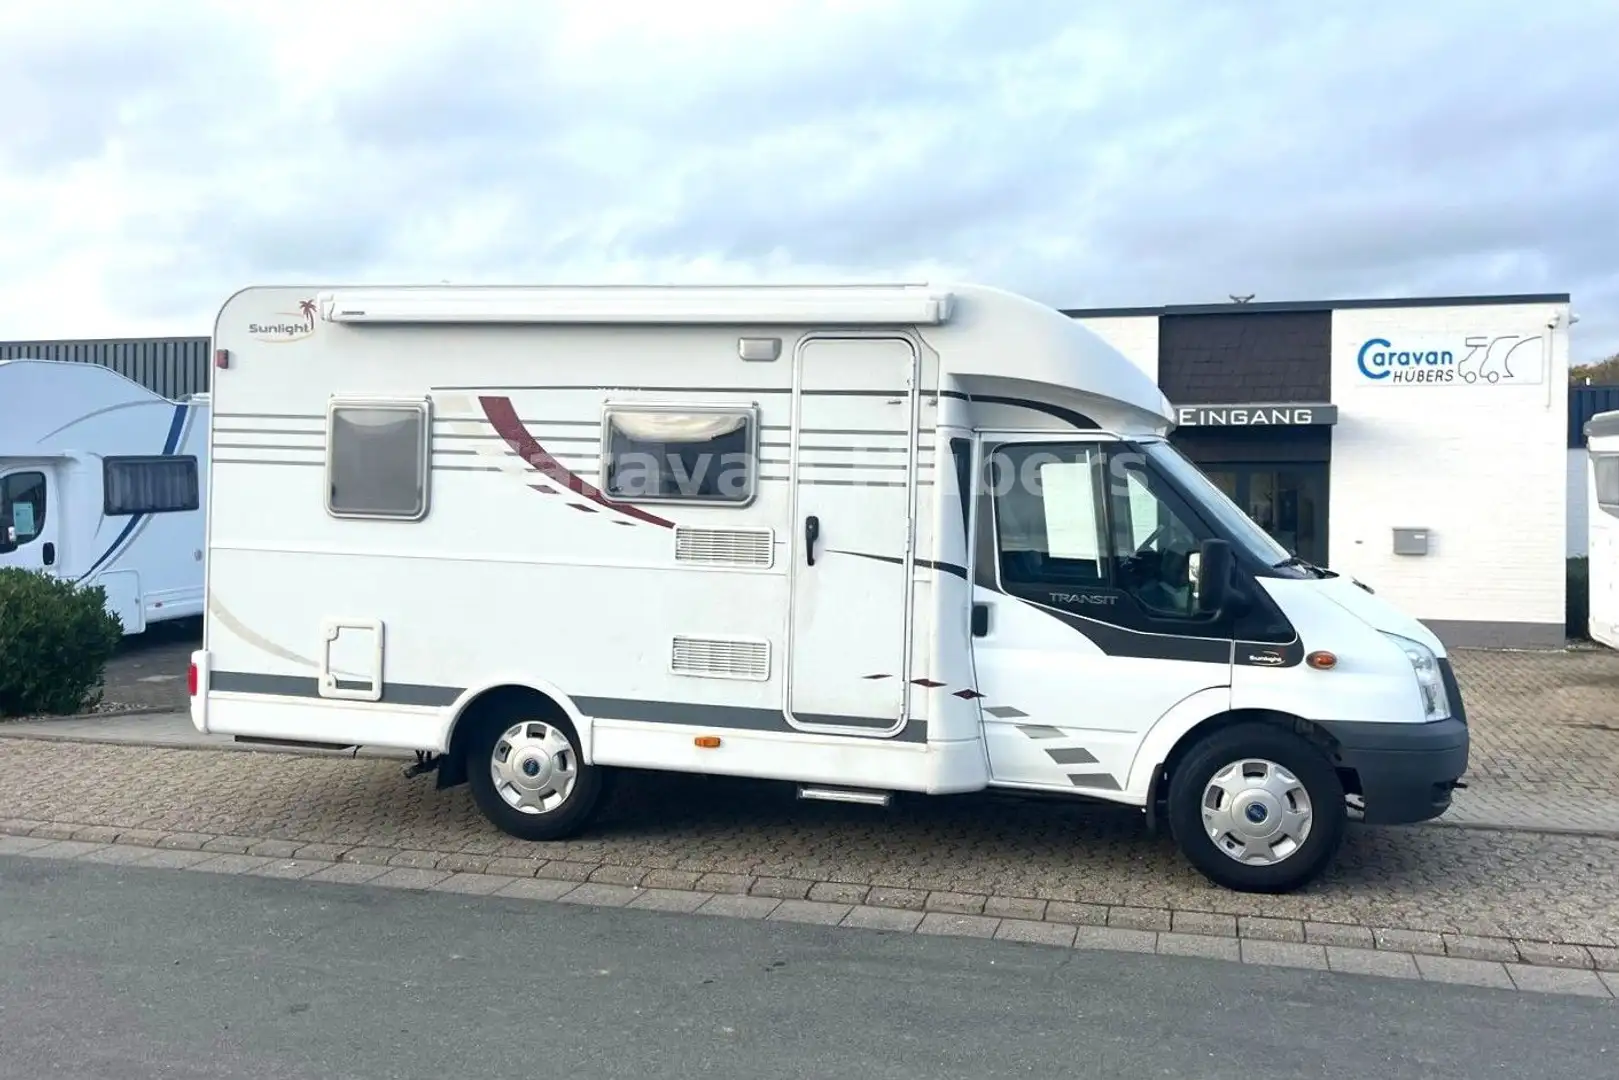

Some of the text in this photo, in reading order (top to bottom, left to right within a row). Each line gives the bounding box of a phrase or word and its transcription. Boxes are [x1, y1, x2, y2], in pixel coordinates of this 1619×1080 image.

[249, 323, 309, 335] Sunlight
[1358, 338, 1453, 379] Caravan
[1393, 366, 1454, 382] HÜBERS
[1179, 408, 1312, 426] EINGANG
[1049, 592, 1118, 605] TRANSIT
